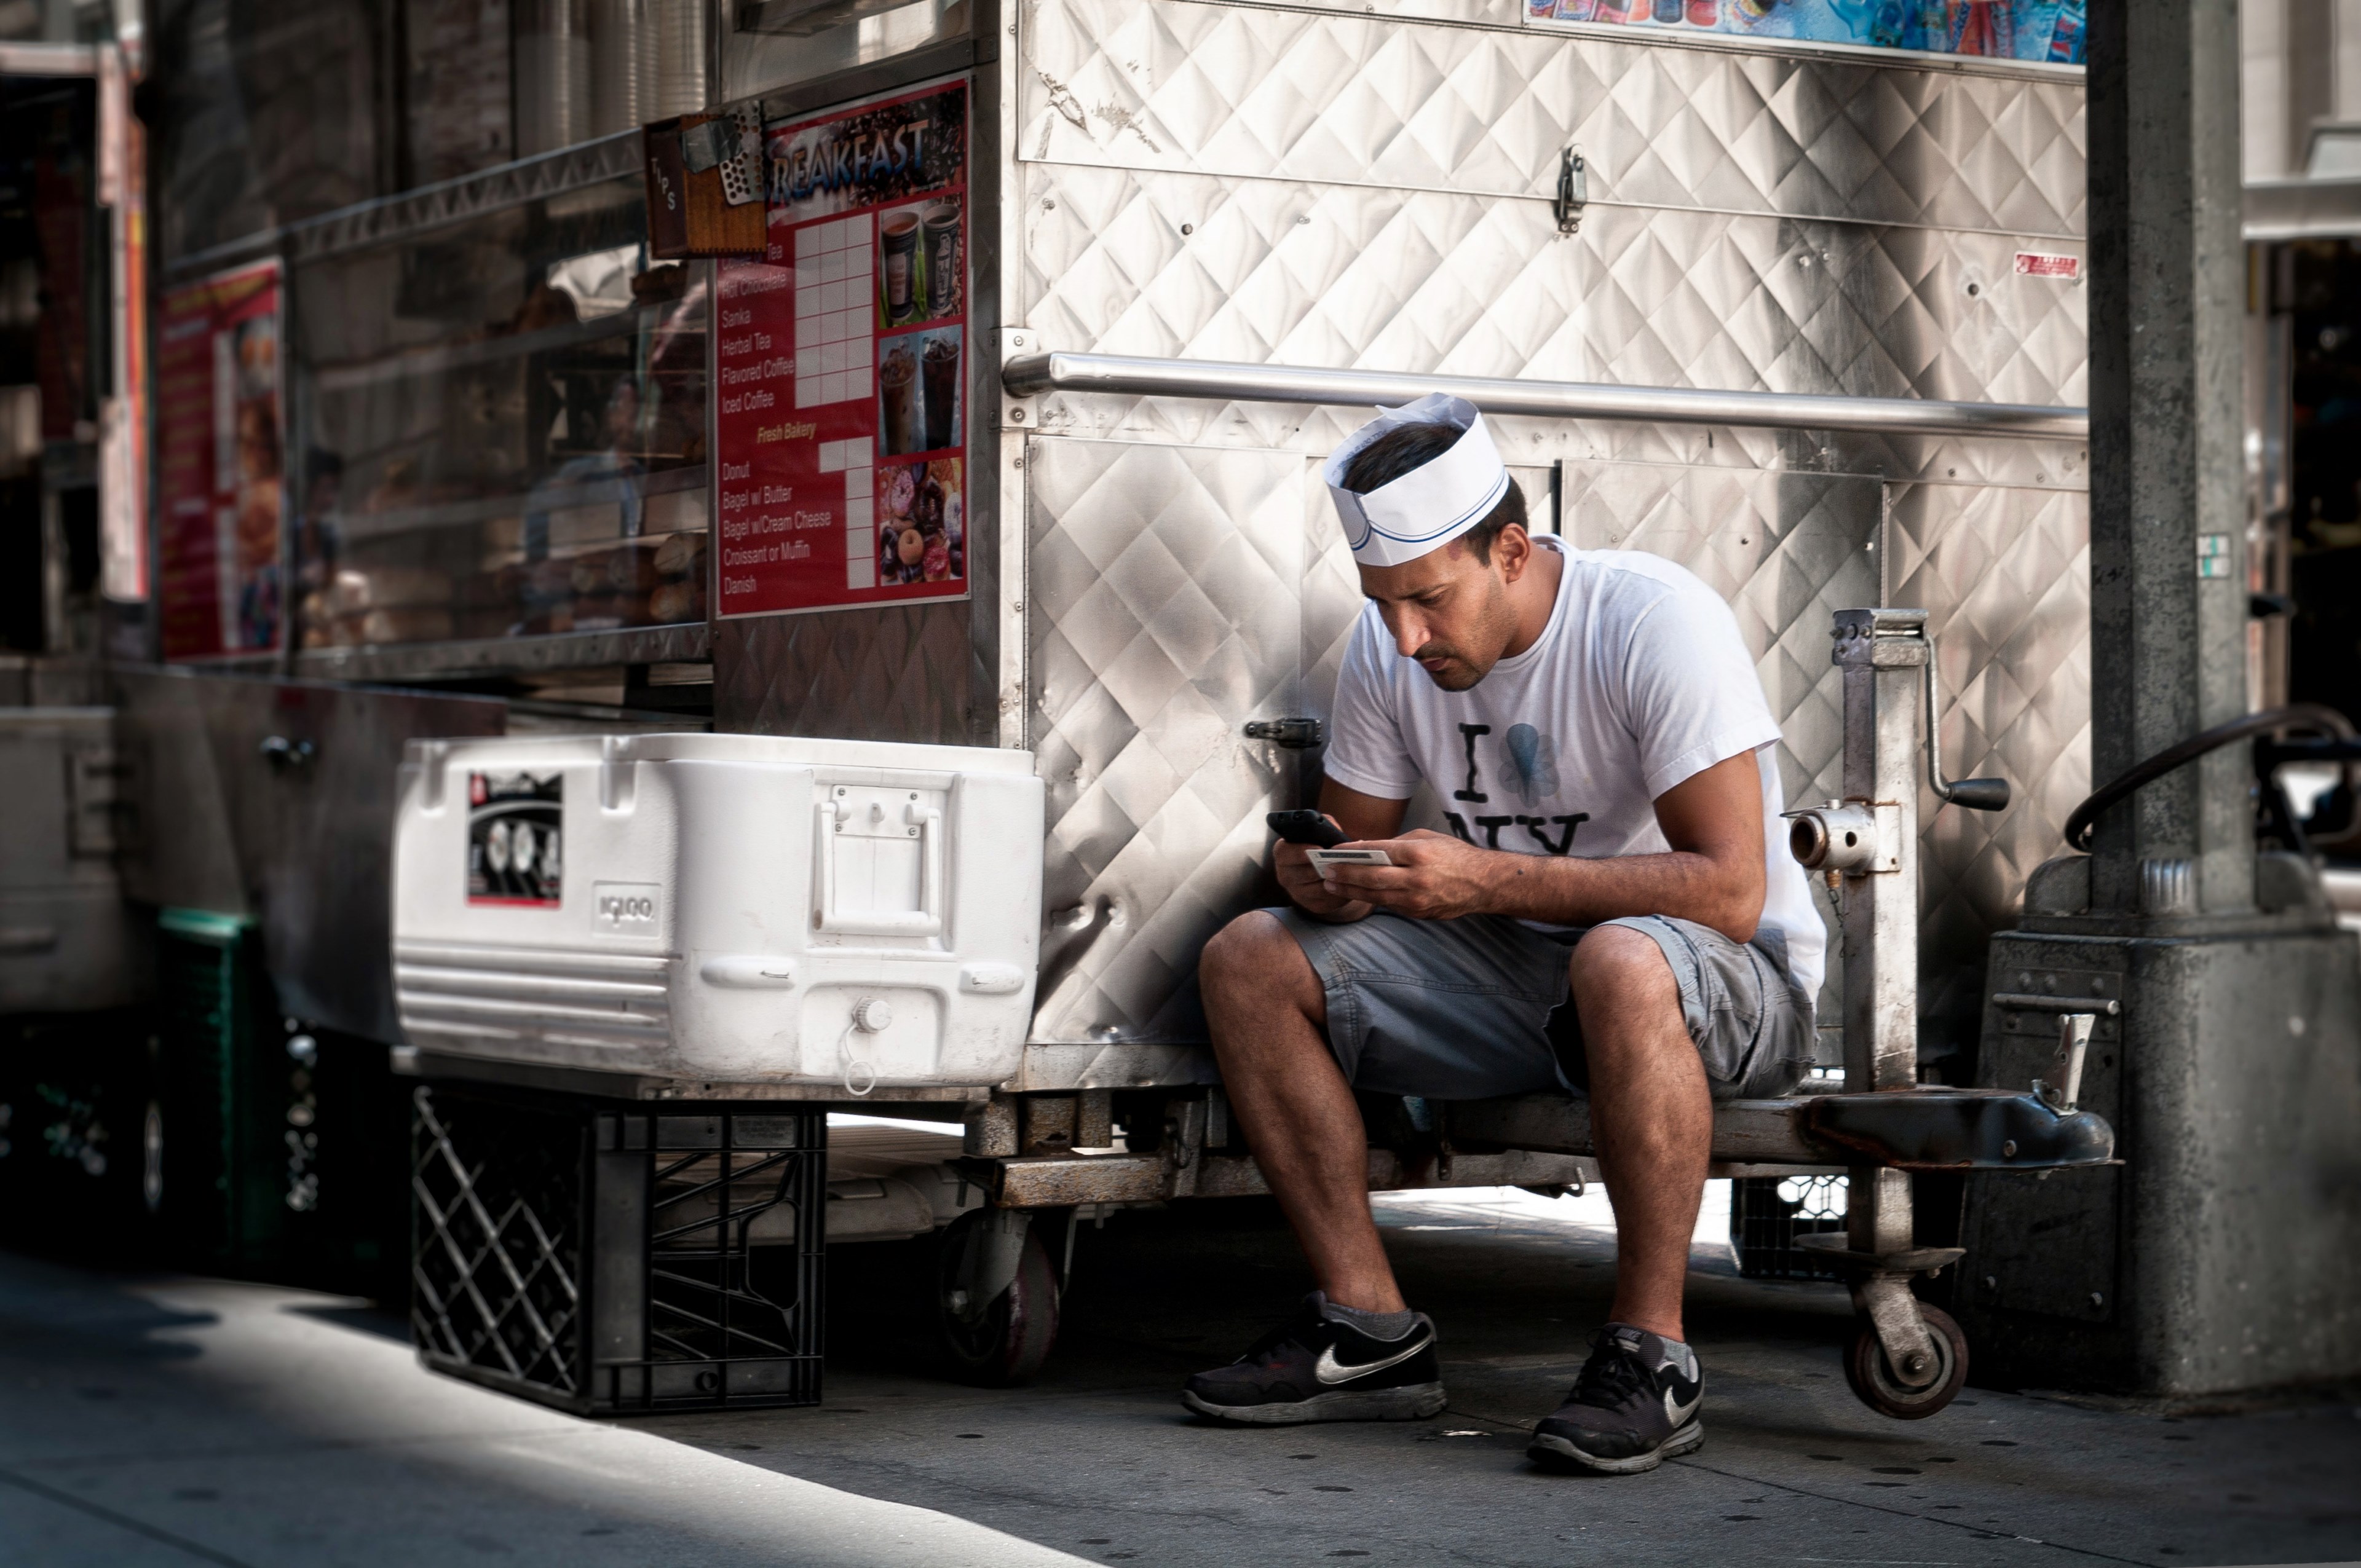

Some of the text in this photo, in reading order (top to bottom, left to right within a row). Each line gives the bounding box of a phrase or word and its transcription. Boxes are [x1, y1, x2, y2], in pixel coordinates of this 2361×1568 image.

[764, 119, 928, 204] REAKFAST
[651, 157, 676, 211] TIPS
[767, 242, 783, 261] Tea
[740, 271, 787, 296] Chocolate
[722, 308, 751, 328] Sanka
[722, 332, 771, 357] Herbal Tea
[722, 357, 794, 385] Flavored Coffee
[722, 390, 775, 414] Iced Coffee
[756, 422, 817, 444] Fresh Bakery
[722, 461, 750, 481] Donut
[723, 489, 749, 513] Bagel
[764, 486, 793, 504] Butter
[724, 518, 749, 541] Bagel
[794, 511, 832, 529] Cheese
[724, 540, 811, 566] Croissant or Muffin
[724, 575, 757, 595] Danish
[1453, 722, 1491, 803] I
